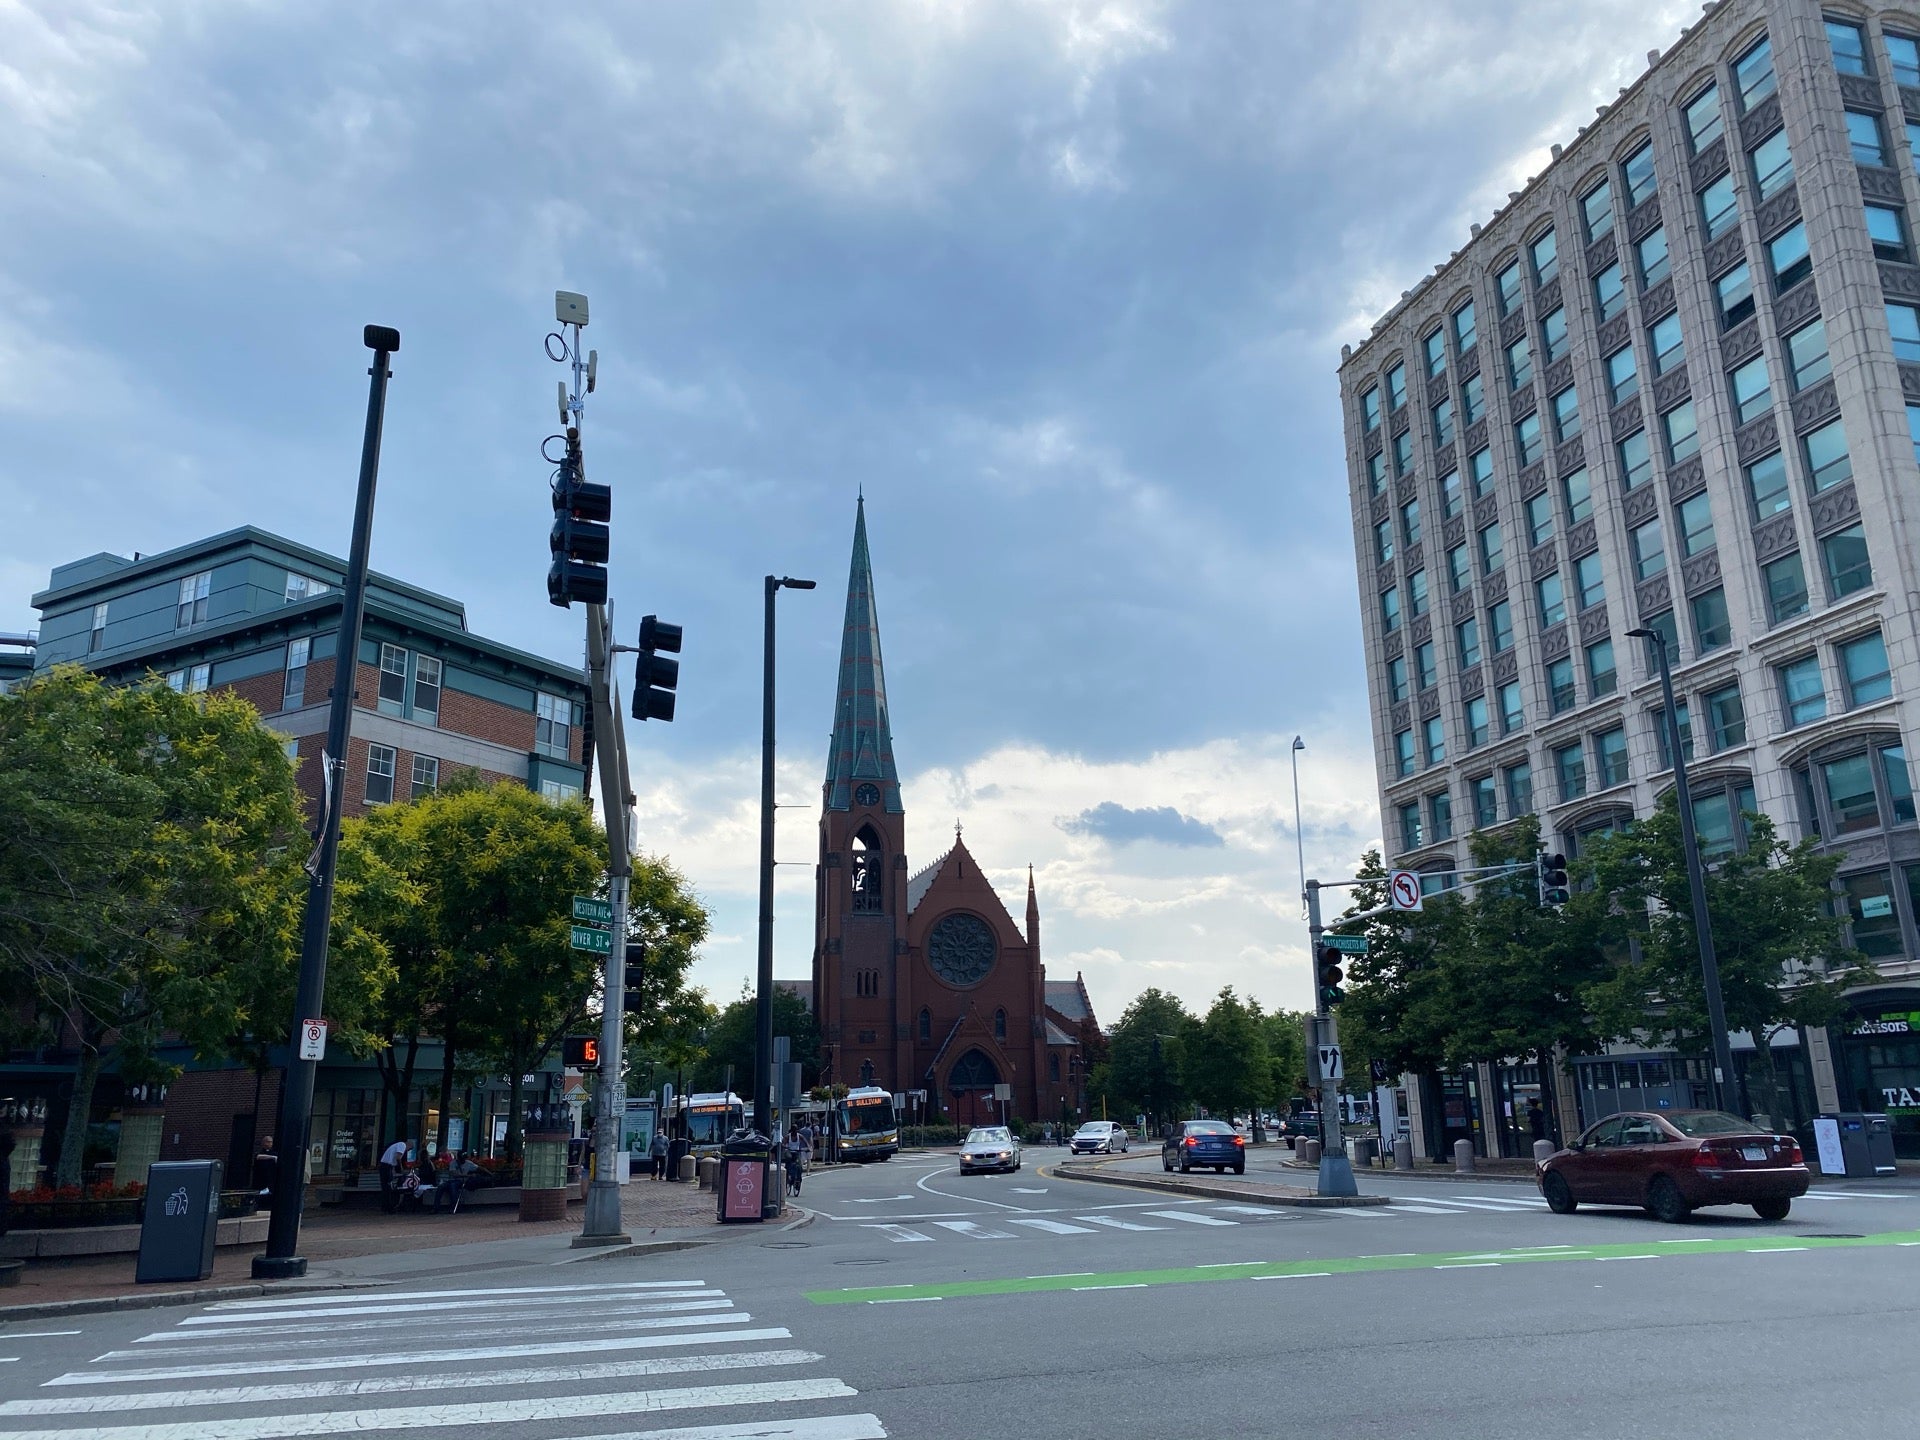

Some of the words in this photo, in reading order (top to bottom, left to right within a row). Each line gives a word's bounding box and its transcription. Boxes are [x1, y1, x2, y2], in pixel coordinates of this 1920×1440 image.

[575, 902, 597, 917] WESTERN
[598, 906, 607, 918] AVE
[573, 931, 591, 946] RIVER
[596, 935, 603, 948] ST
[585, 1041, 596, 1060] 16
[562, 1094, 592, 1102] SUBWAY
